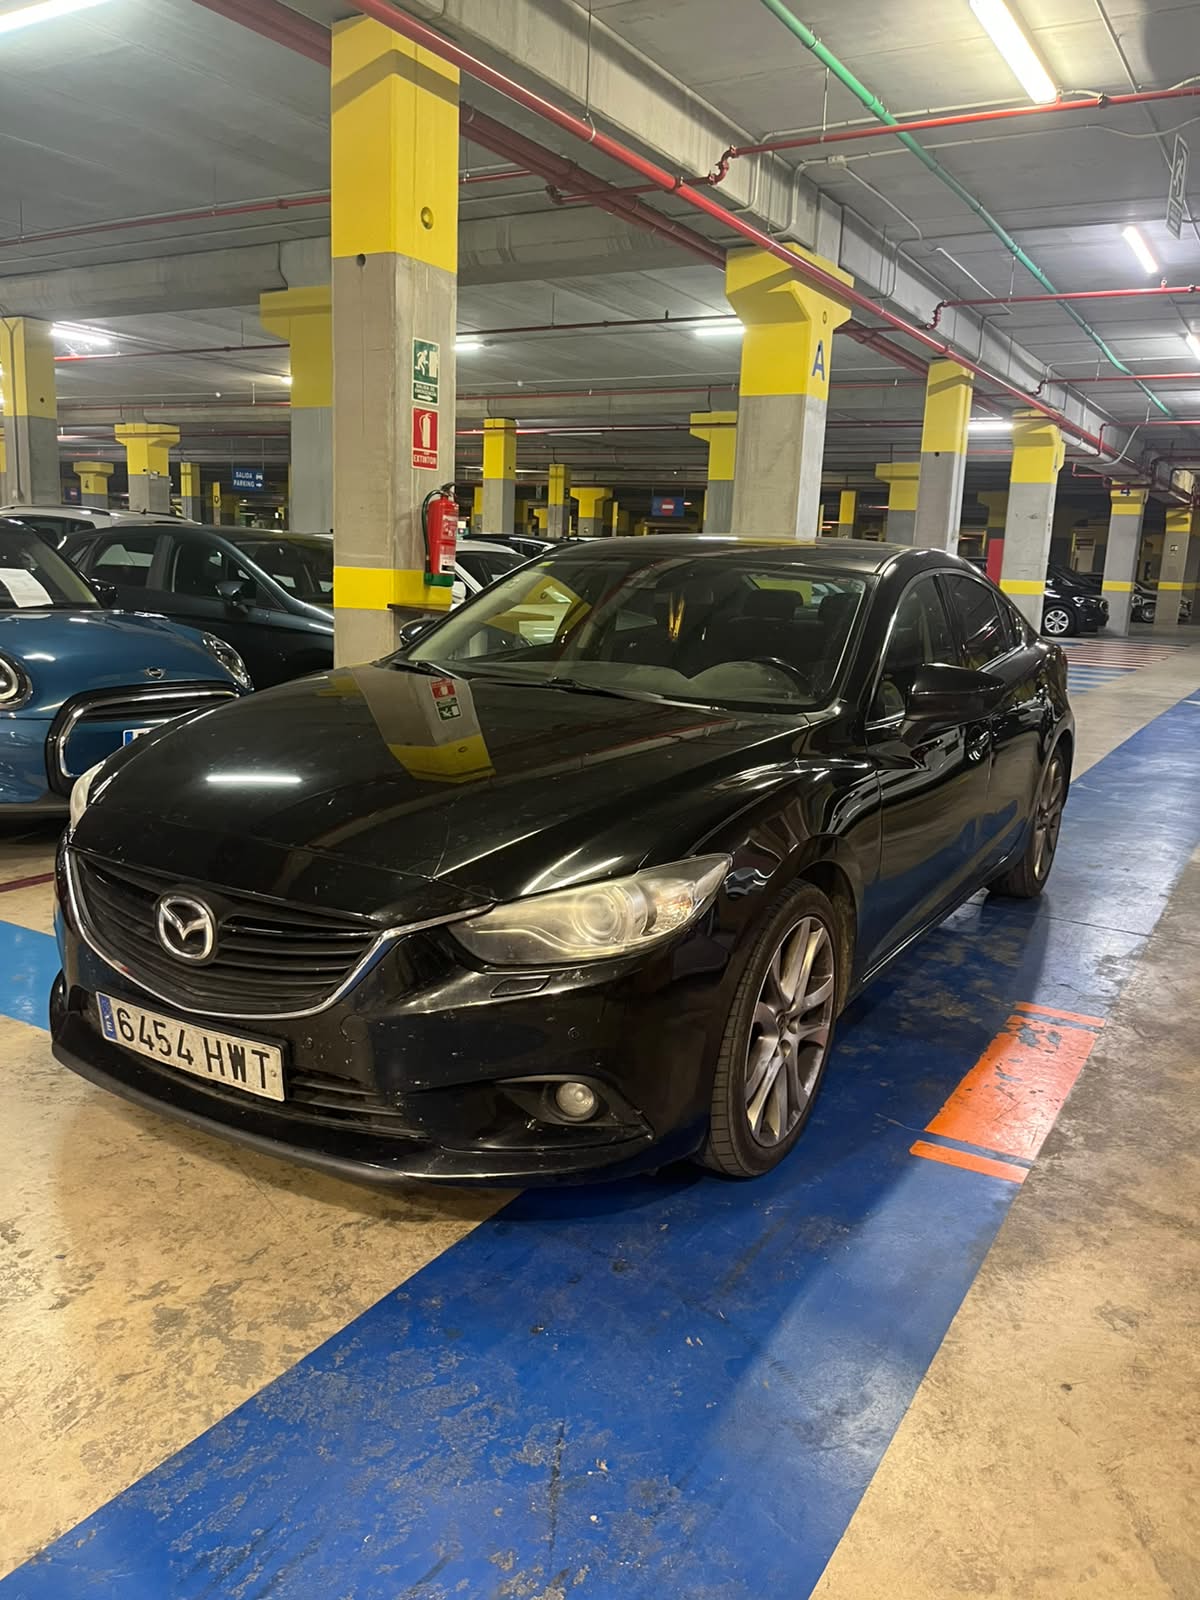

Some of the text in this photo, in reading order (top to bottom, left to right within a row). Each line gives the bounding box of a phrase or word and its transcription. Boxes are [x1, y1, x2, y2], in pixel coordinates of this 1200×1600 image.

[811, 339, 825, 381] A
[413, 454, 436, 465] EXTINTOR
[235, 471, 252, 479] SALIDA
[233, 479, 255, 488] PARKING
[1120, 488, 1131, 497] 4
[116, 1007, 270, 1089] 6454 HWT
